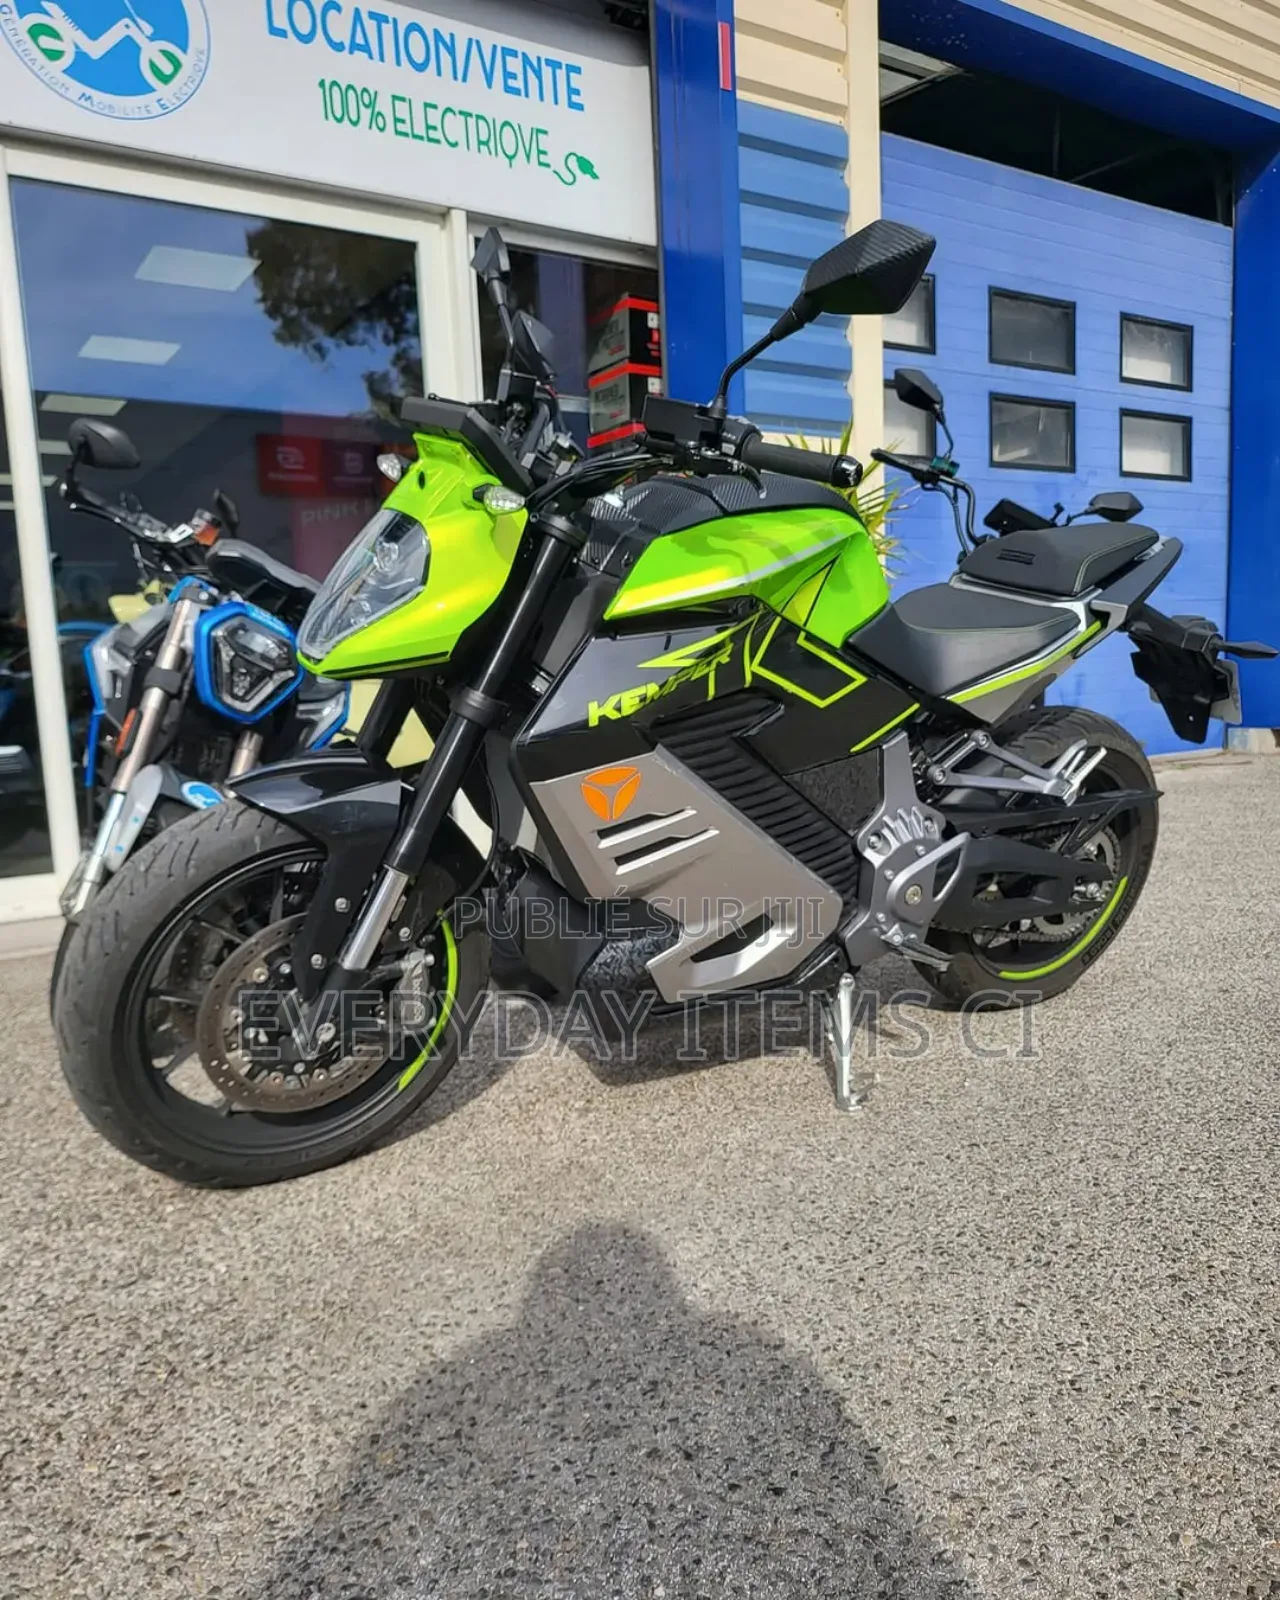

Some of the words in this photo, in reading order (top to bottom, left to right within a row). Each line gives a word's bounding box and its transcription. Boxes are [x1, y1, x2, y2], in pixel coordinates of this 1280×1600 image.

[265, 0, 586, 112] LOCATION/VENTE
[318, 78, 387, 133] 100%
[588, 641, 735, 728] KEMPER
